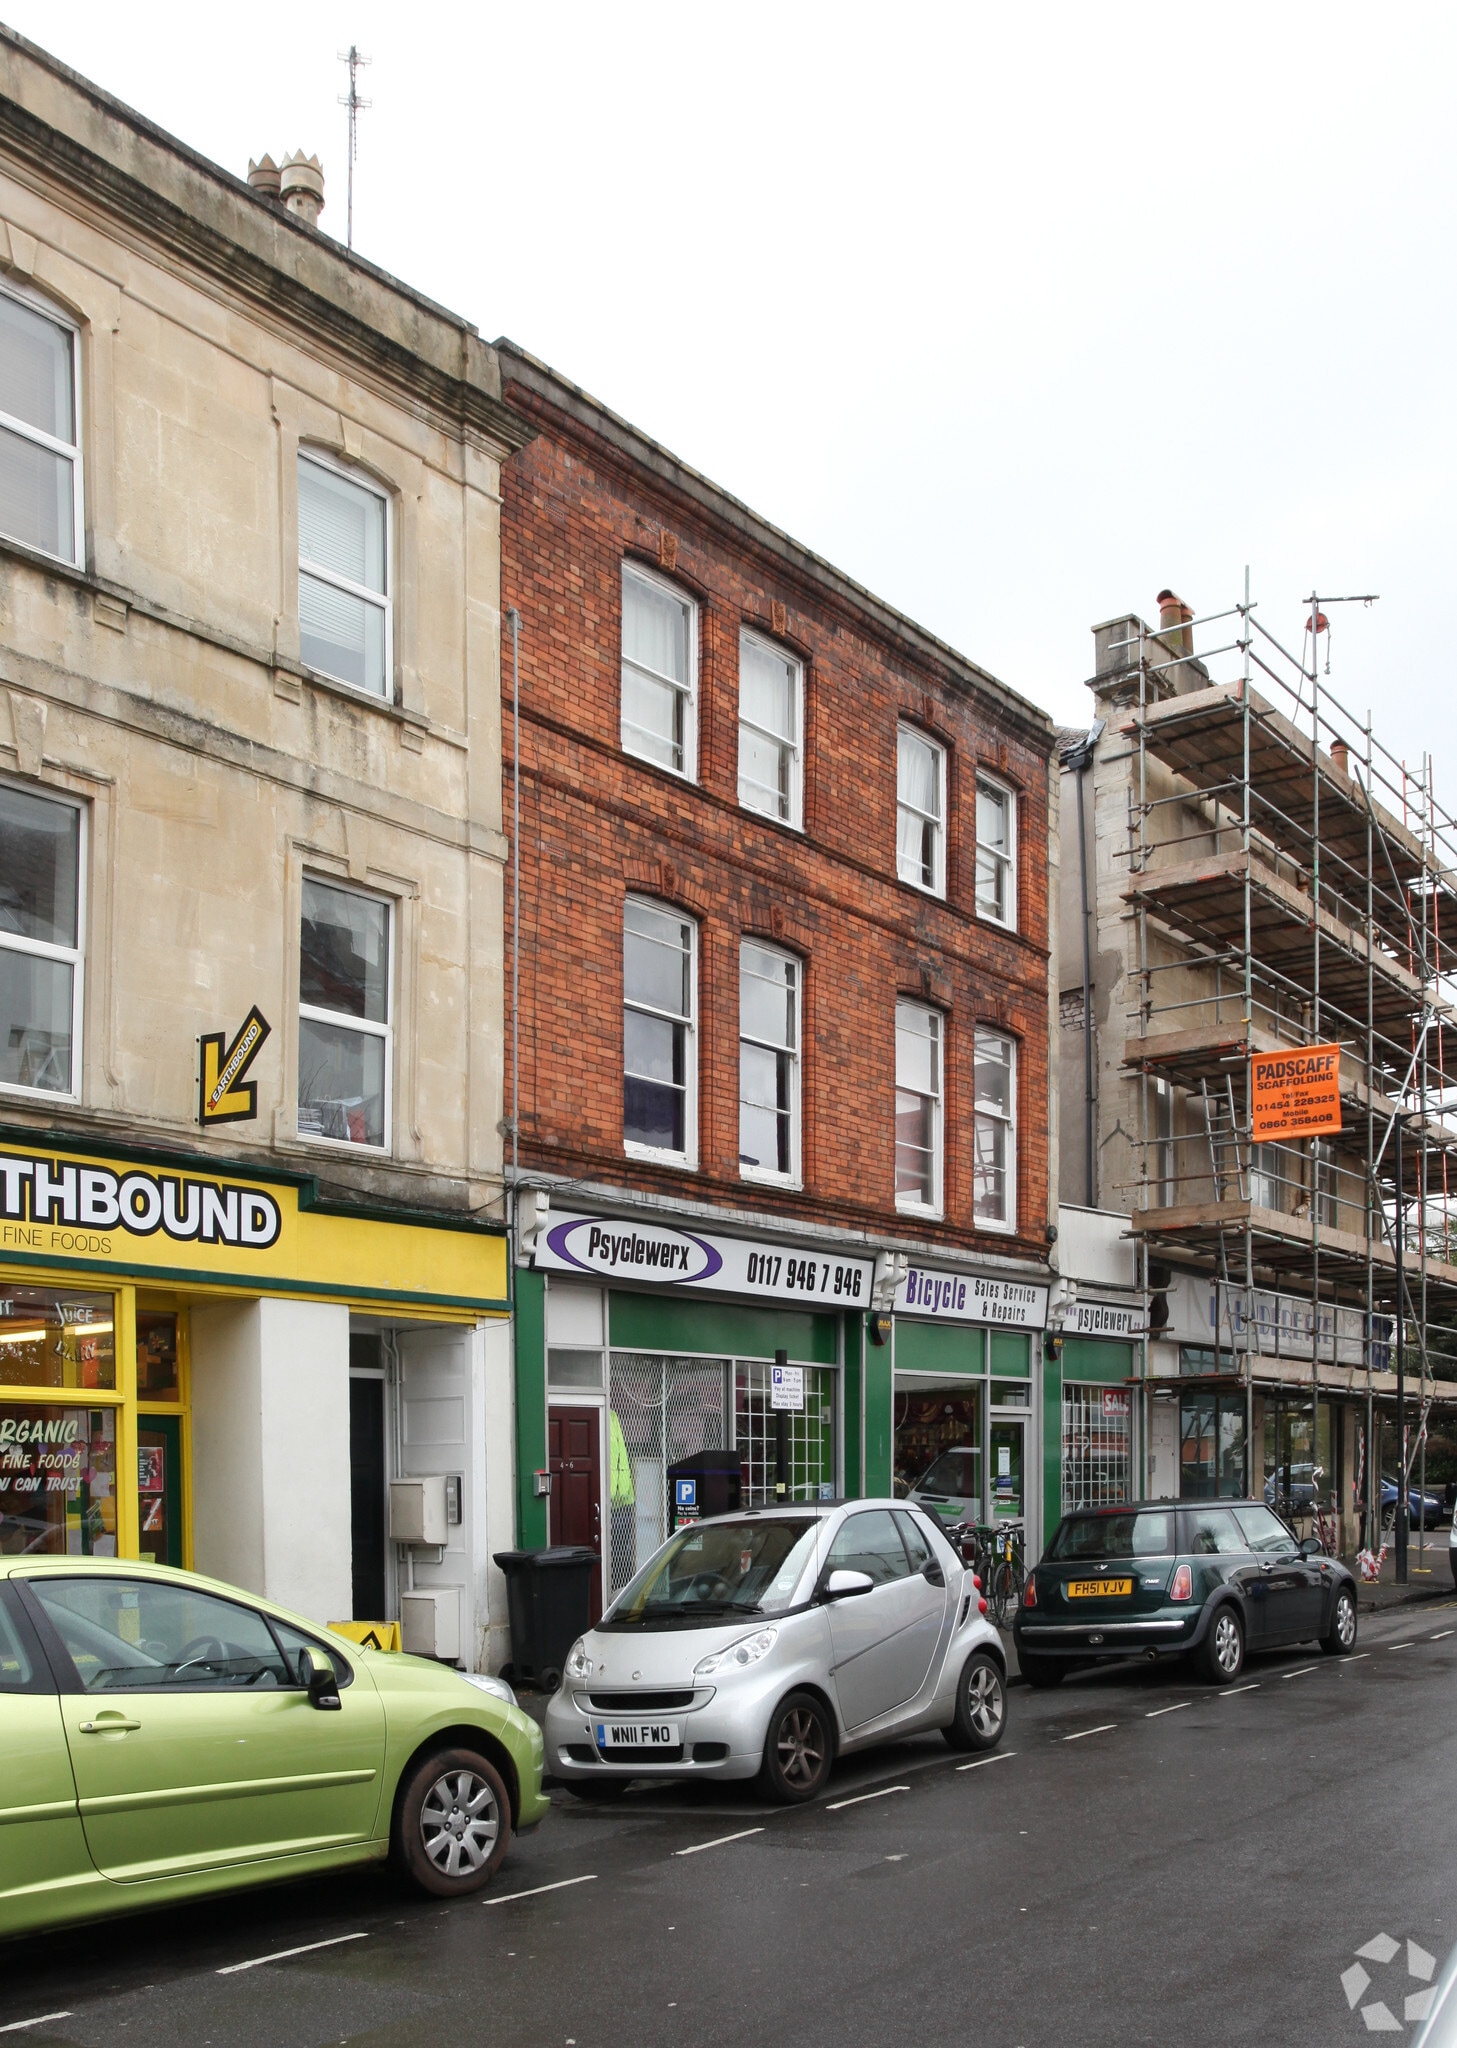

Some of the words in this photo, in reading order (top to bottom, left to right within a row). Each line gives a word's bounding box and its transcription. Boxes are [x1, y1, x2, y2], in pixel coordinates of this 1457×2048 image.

[212, 1025, 258, 1102] EARTHBOUND
[1256, 1056, 1335, 1080] PADSCAFF
[1257, 1072, 1334, 1090] SCAFFOLDING
[1256, 1101, 1290, 1111] 01454
[1282, 1109, 1308, 1117] Mobile
[0, 1158, 277, 1244] THBOUND
[4, 1226, 42, 1246] FINE
[51, 1232, 112, 1254] FOODS
[588, 1226, 690, 1271] Psyclewerx
[747, 1252, 782, 1287] 0117
[786, 1260, 816, 1292] 946
[820, 1264, 830, 1293] 7
[834, 1268, 862, 1298] 946
[906, 1270, 966, 1312] Bicycle
[974, 1280, 1000, 1299] Sales
[1003, 1284, 1036, 1303] Service
[982, 1301, 988, 1317] &
[992, 1302, 1026, 1321] Repairs
[1105, 1394, 1130, 1412] SALE
[0, 1418, 78, 1443] RGANIC
[2, 1454, 32, 1468] FINE
[38, 1454, 81, 1469] FOODS
[15, 1477, 42, 1491] CAN
[46, 1477, 84, 1491] TRUST
[1075, 1583, 1100, 1594] FH51
[1103, 1582, 1125, 1592] VJV
[612, 1727, 638, 1743] WN11
[641, 1726, 670, 1742] FWO
